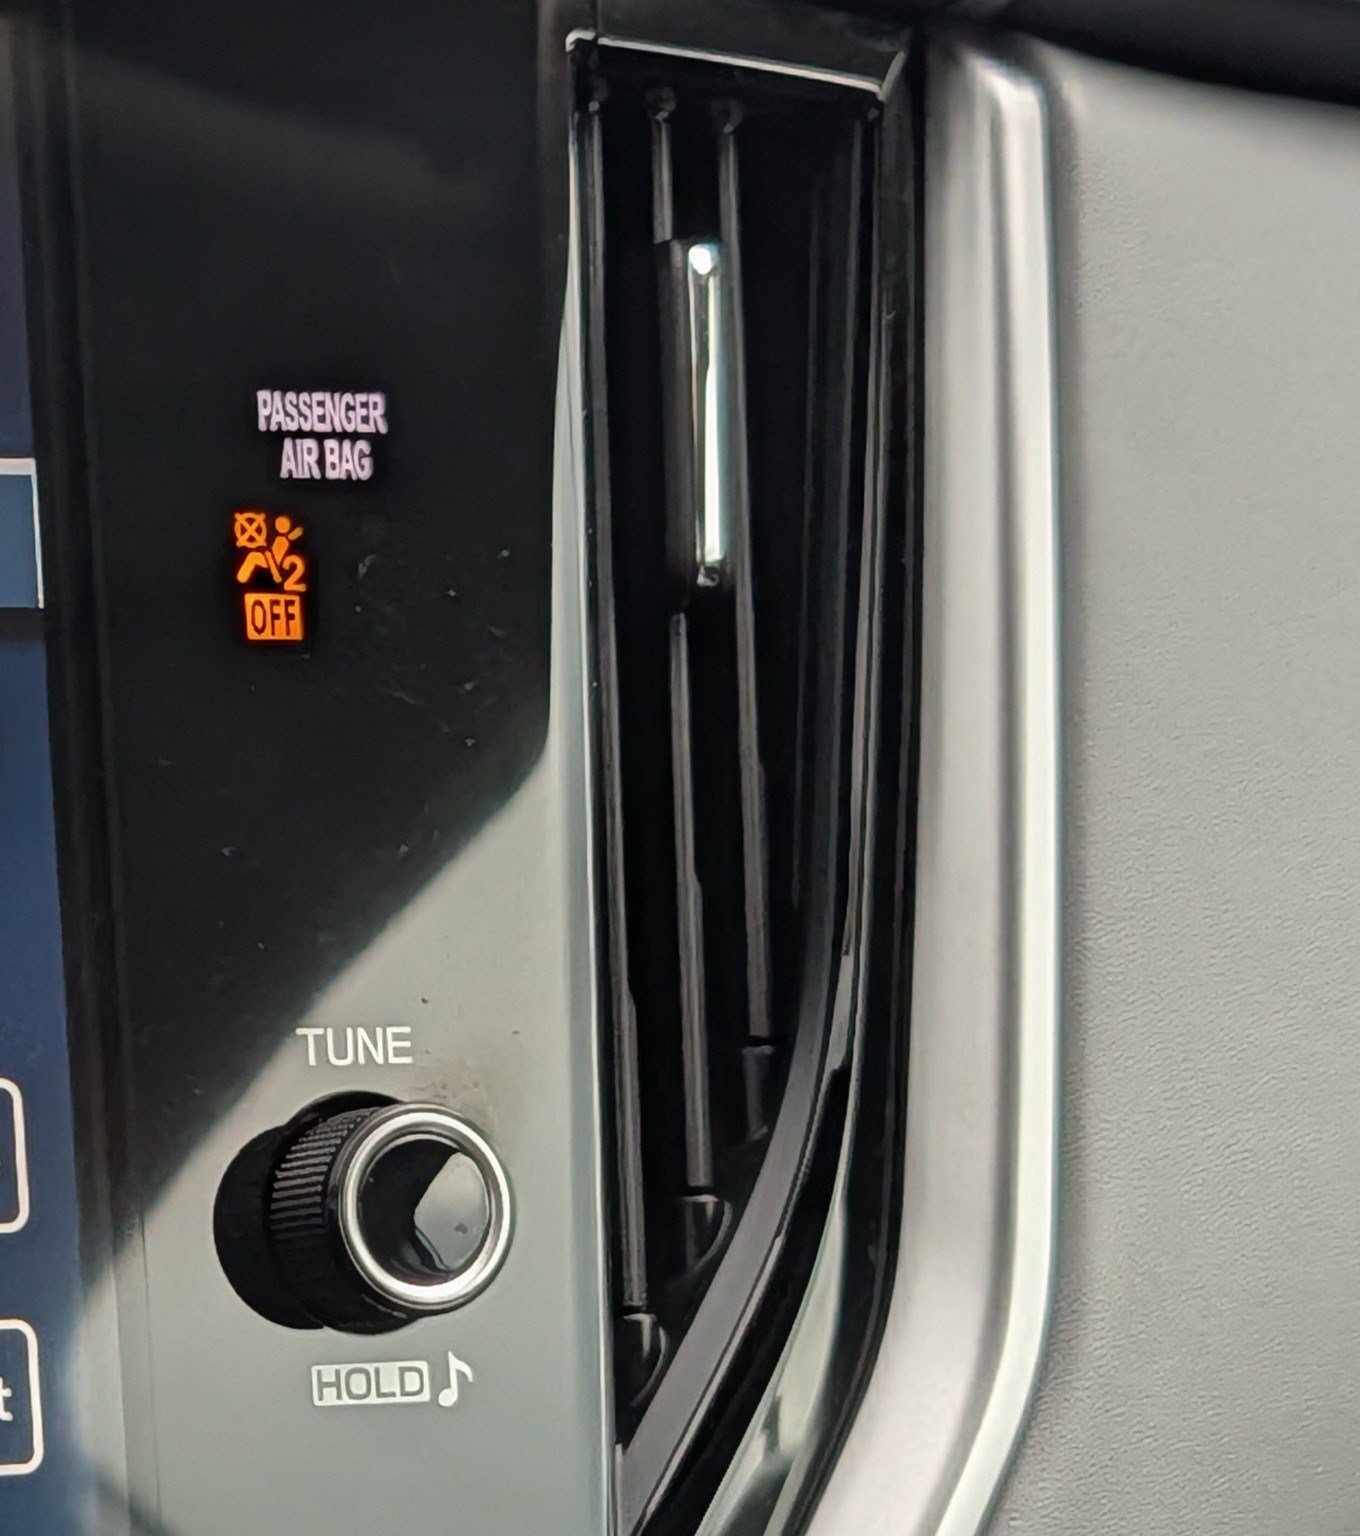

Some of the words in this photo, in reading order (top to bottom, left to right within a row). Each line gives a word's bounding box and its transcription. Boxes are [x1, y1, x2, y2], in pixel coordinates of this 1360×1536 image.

[256, 389, 388, 434] PASSENGER
[280, 438, 321, 479] AIR
[324, 439, 373, 481] BAG
[249, 598, 296, 636] OFF
[295, 1026, 414, 1066] TUNE
[316, 1366, 425, 1401] HOLD
